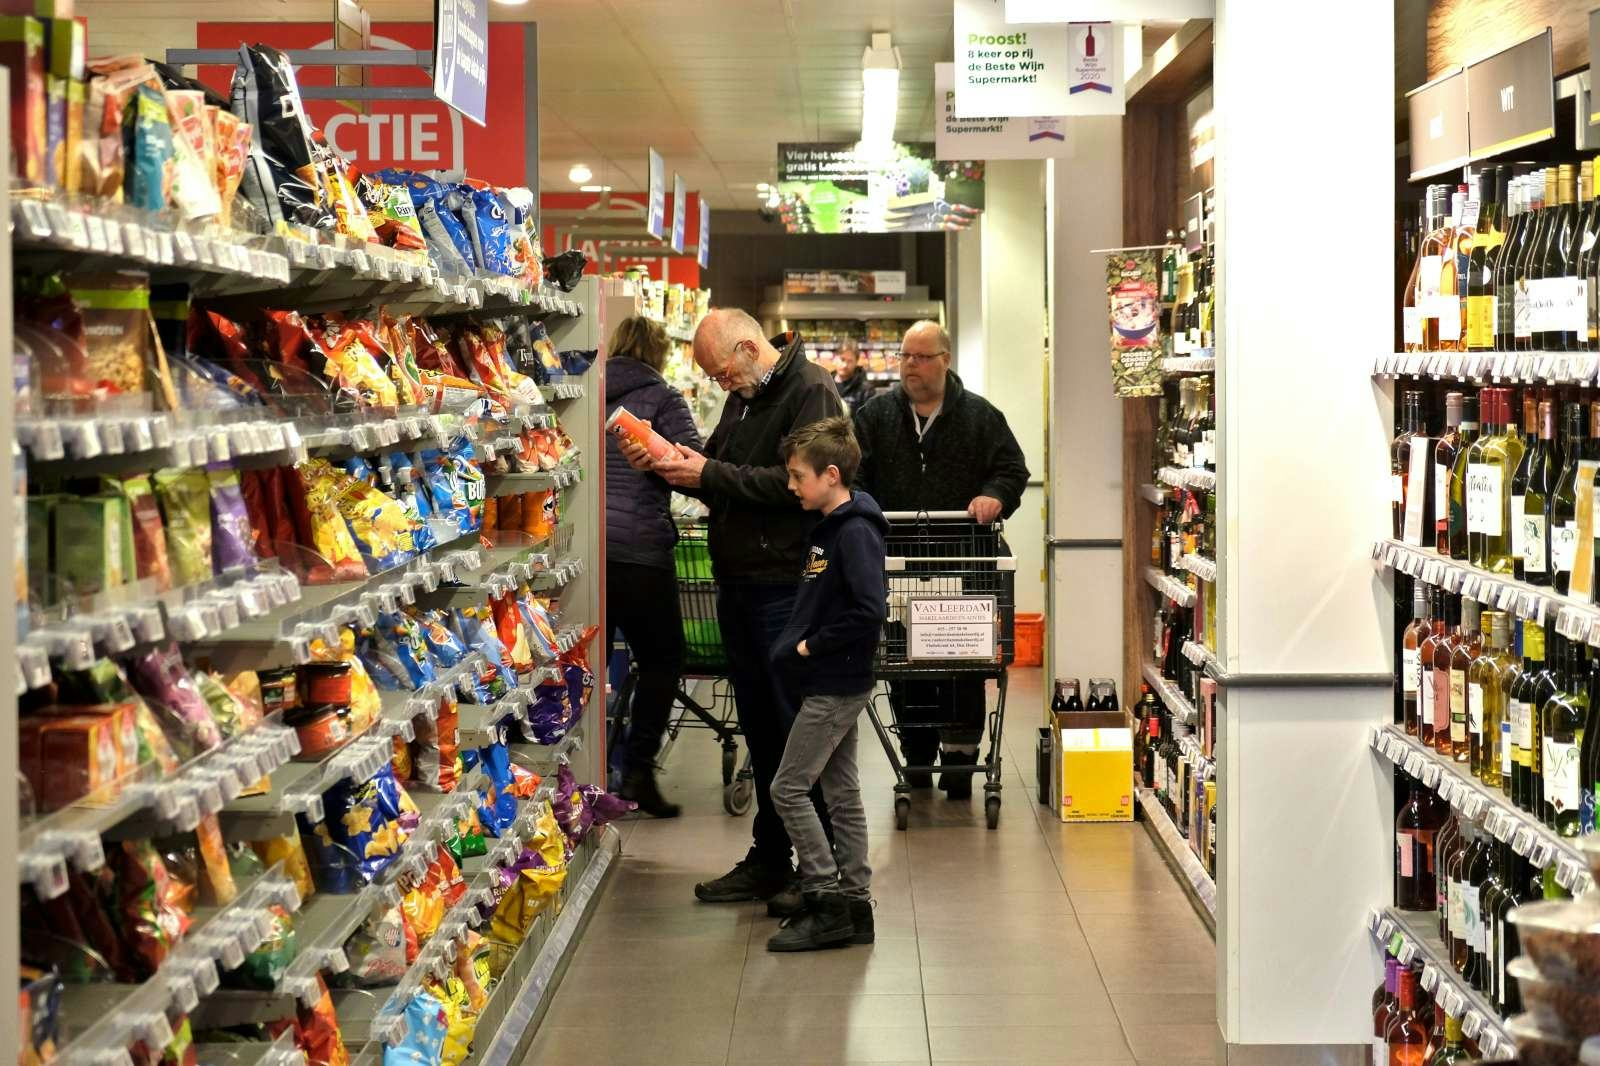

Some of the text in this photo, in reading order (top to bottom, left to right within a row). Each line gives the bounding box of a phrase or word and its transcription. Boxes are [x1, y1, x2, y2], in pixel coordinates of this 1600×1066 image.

[968, 33, 1026, 45] Proost!
[968, 49, 1034, 60] 8 keer op rij
[968, 61, 1045, 72] de Beste Wijn
[968, 75, 1037, 85] Supermarkt!
[946, 124, 1003, 133] Supermarkt!
[304, 113, 440, 161] CTIE
[786, 151, 808, 160] Vier
[810, 151, 828, 160] het
[786, 162, 817, 173] gratis
[914, 602, 990, 612] VAN LEERDAM
